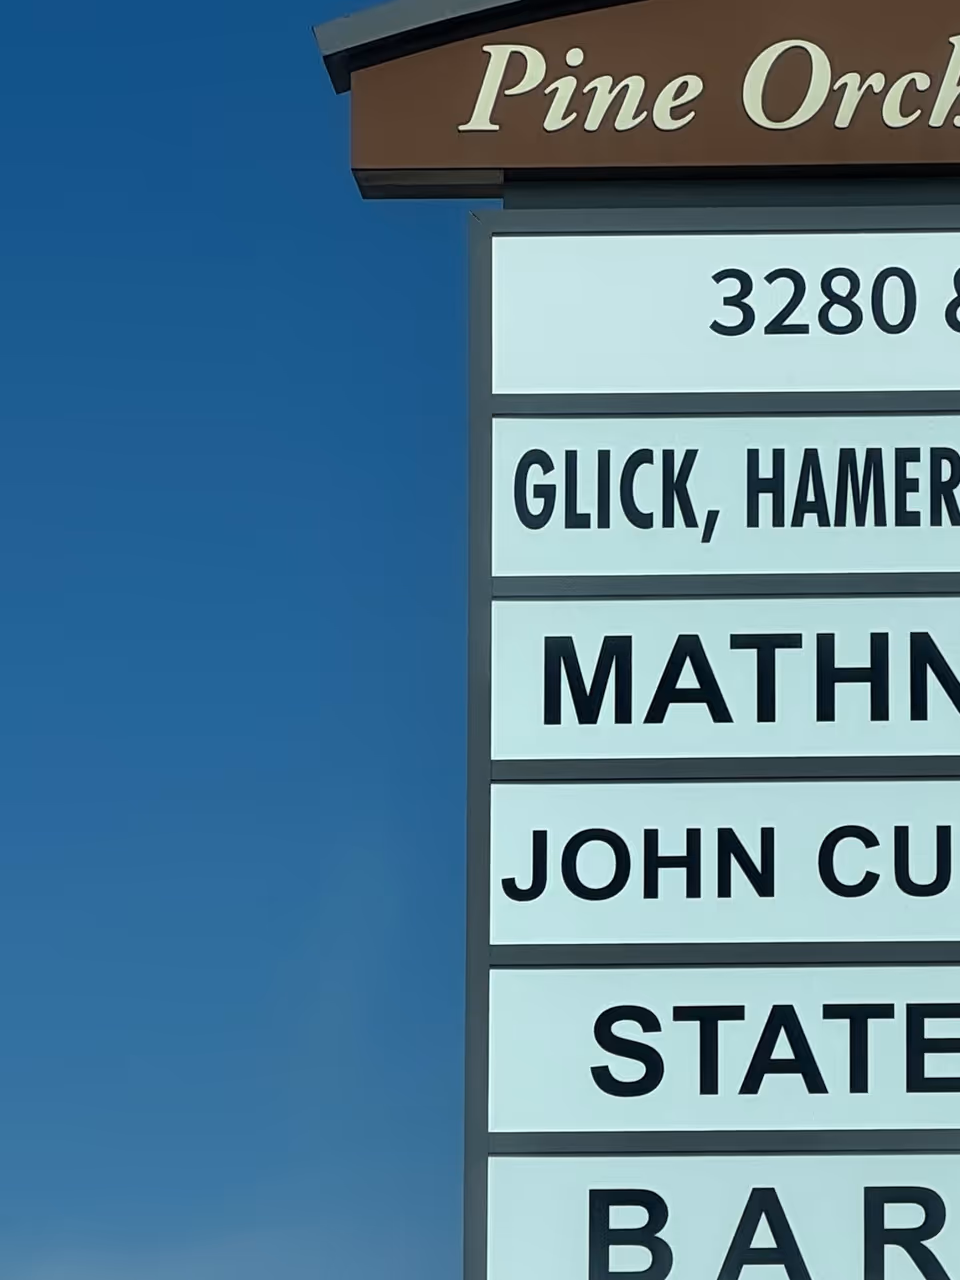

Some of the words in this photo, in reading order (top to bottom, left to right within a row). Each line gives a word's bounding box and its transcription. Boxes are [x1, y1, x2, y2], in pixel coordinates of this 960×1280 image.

[457, 44, 704, 131] Pine
[709, 266, 917, 337] 3280
[513, 447, 720, 544] GLICK,
[501, 826, 775, 903] JOHN
